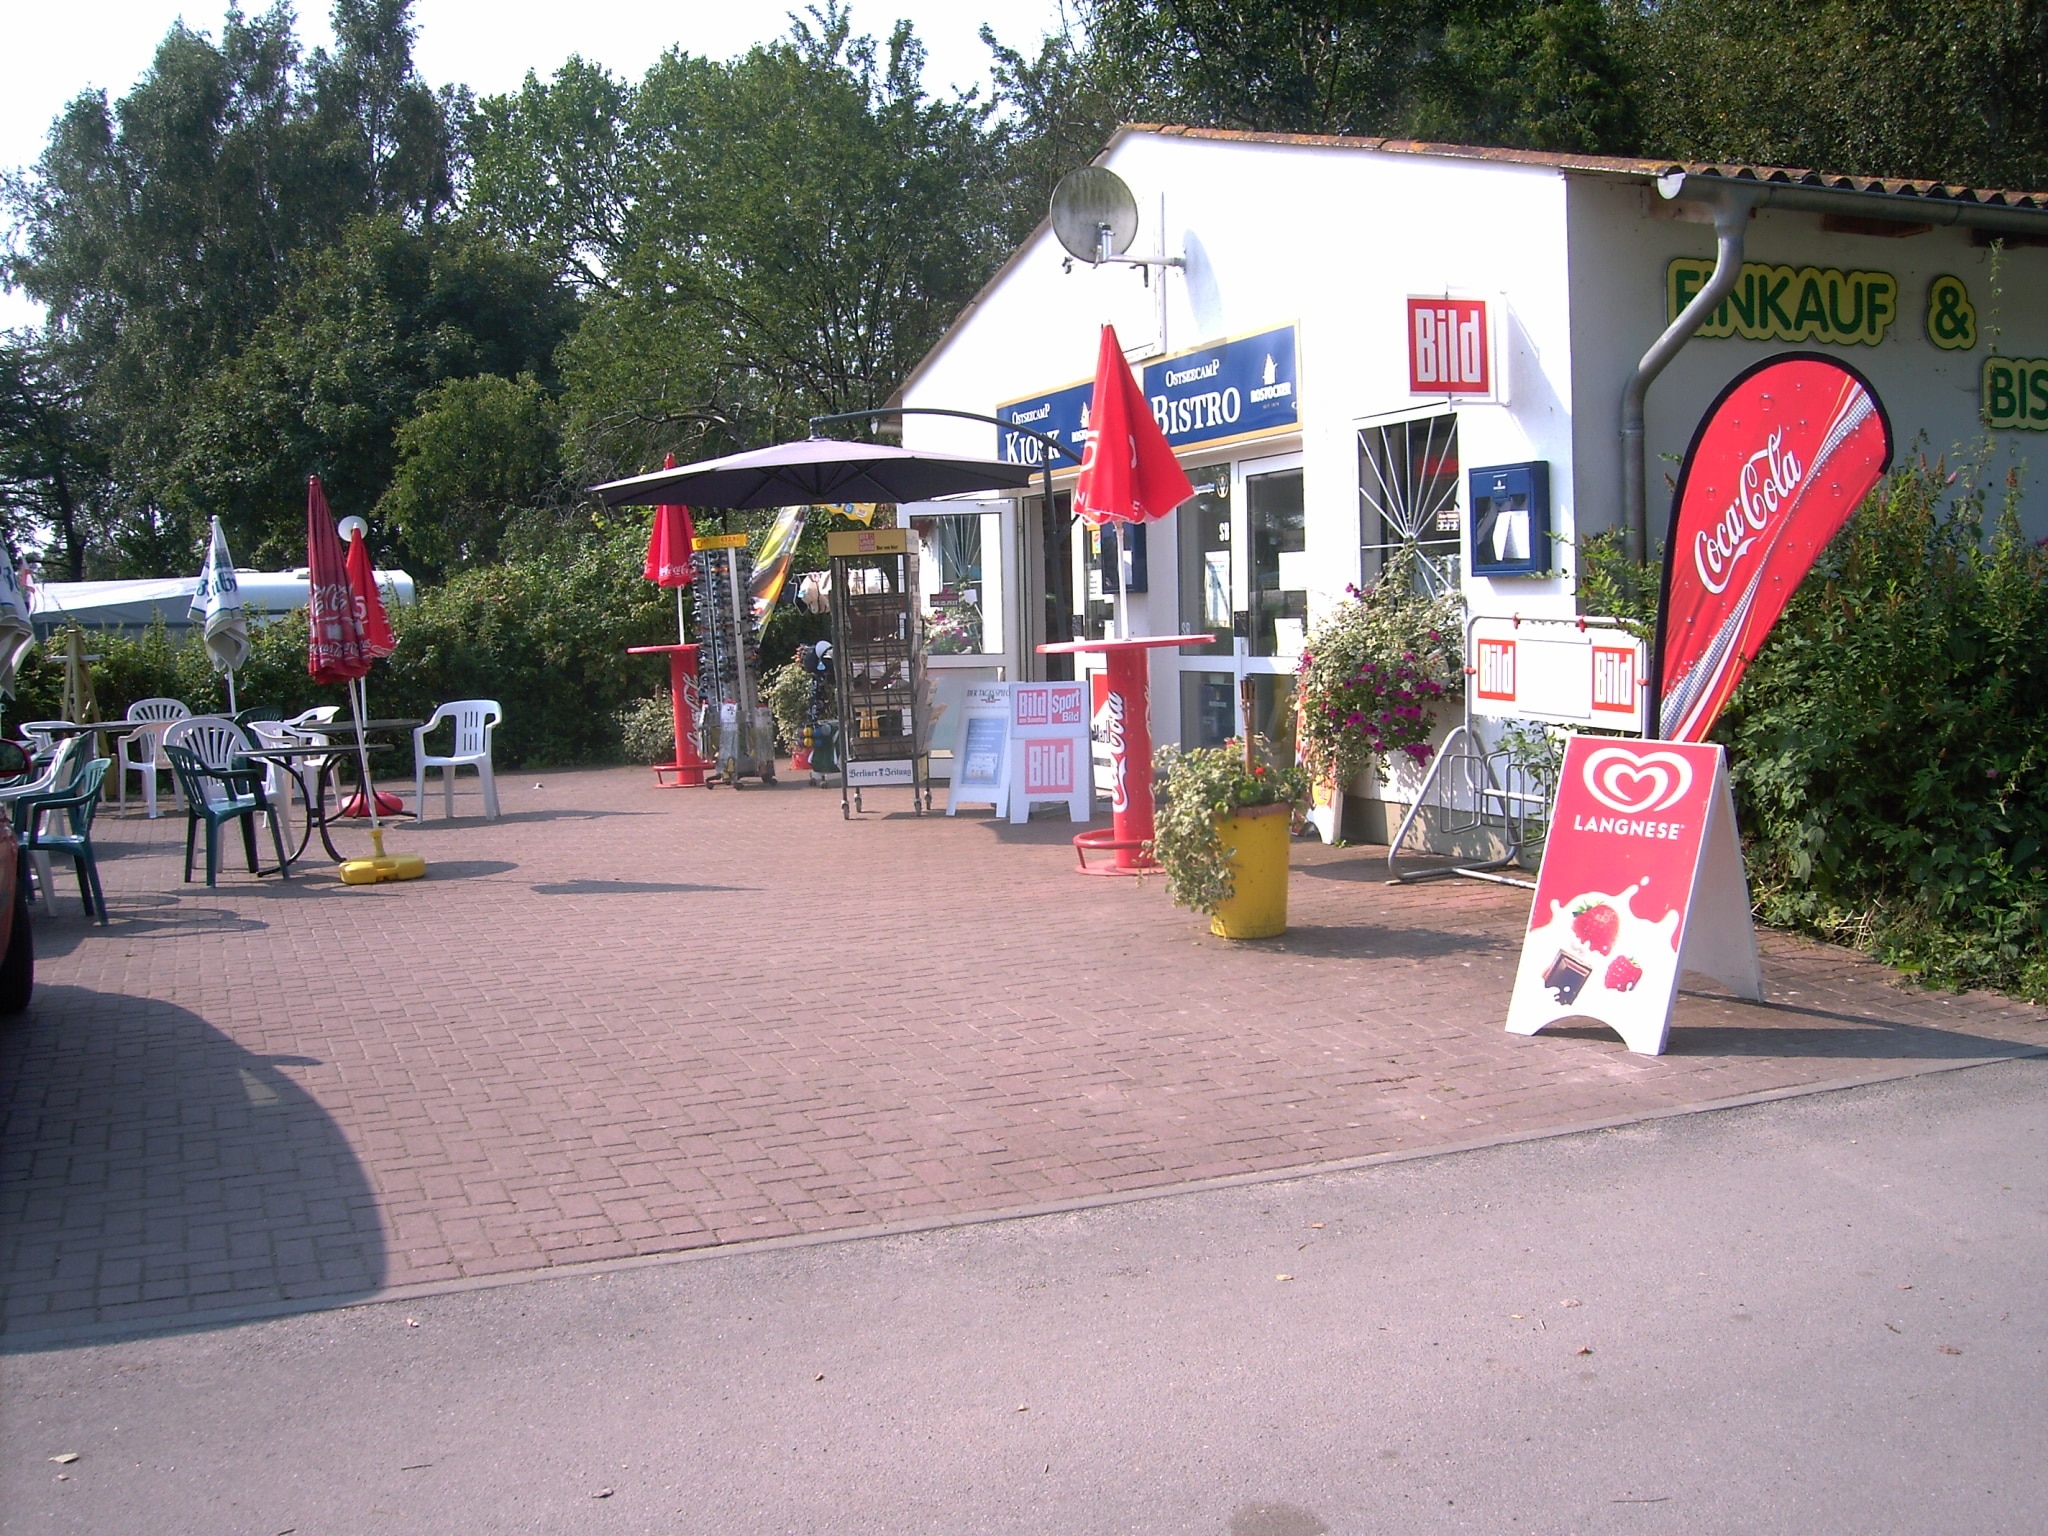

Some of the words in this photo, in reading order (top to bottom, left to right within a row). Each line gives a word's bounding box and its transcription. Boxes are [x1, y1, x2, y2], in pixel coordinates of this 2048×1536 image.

[1934, 285, 1970, 340] &
[1415, 308, 1481, 383] Bild
[1151, 387, 1241, 436] BISTRO
[1990, 367, 2048, 420] BIS
[1480, 643, 1514, 694] Bild
[1594, 651, 1633, 705] Bild
[1019, 692, 1047, 717] Bild
[1053, 690, 1080, 714] Sport
[1062, 711, 1079, 722] Bild
[1029, 745, 1070, 787] Bild
[1573, 814, 1681, 840] LANGNESE
